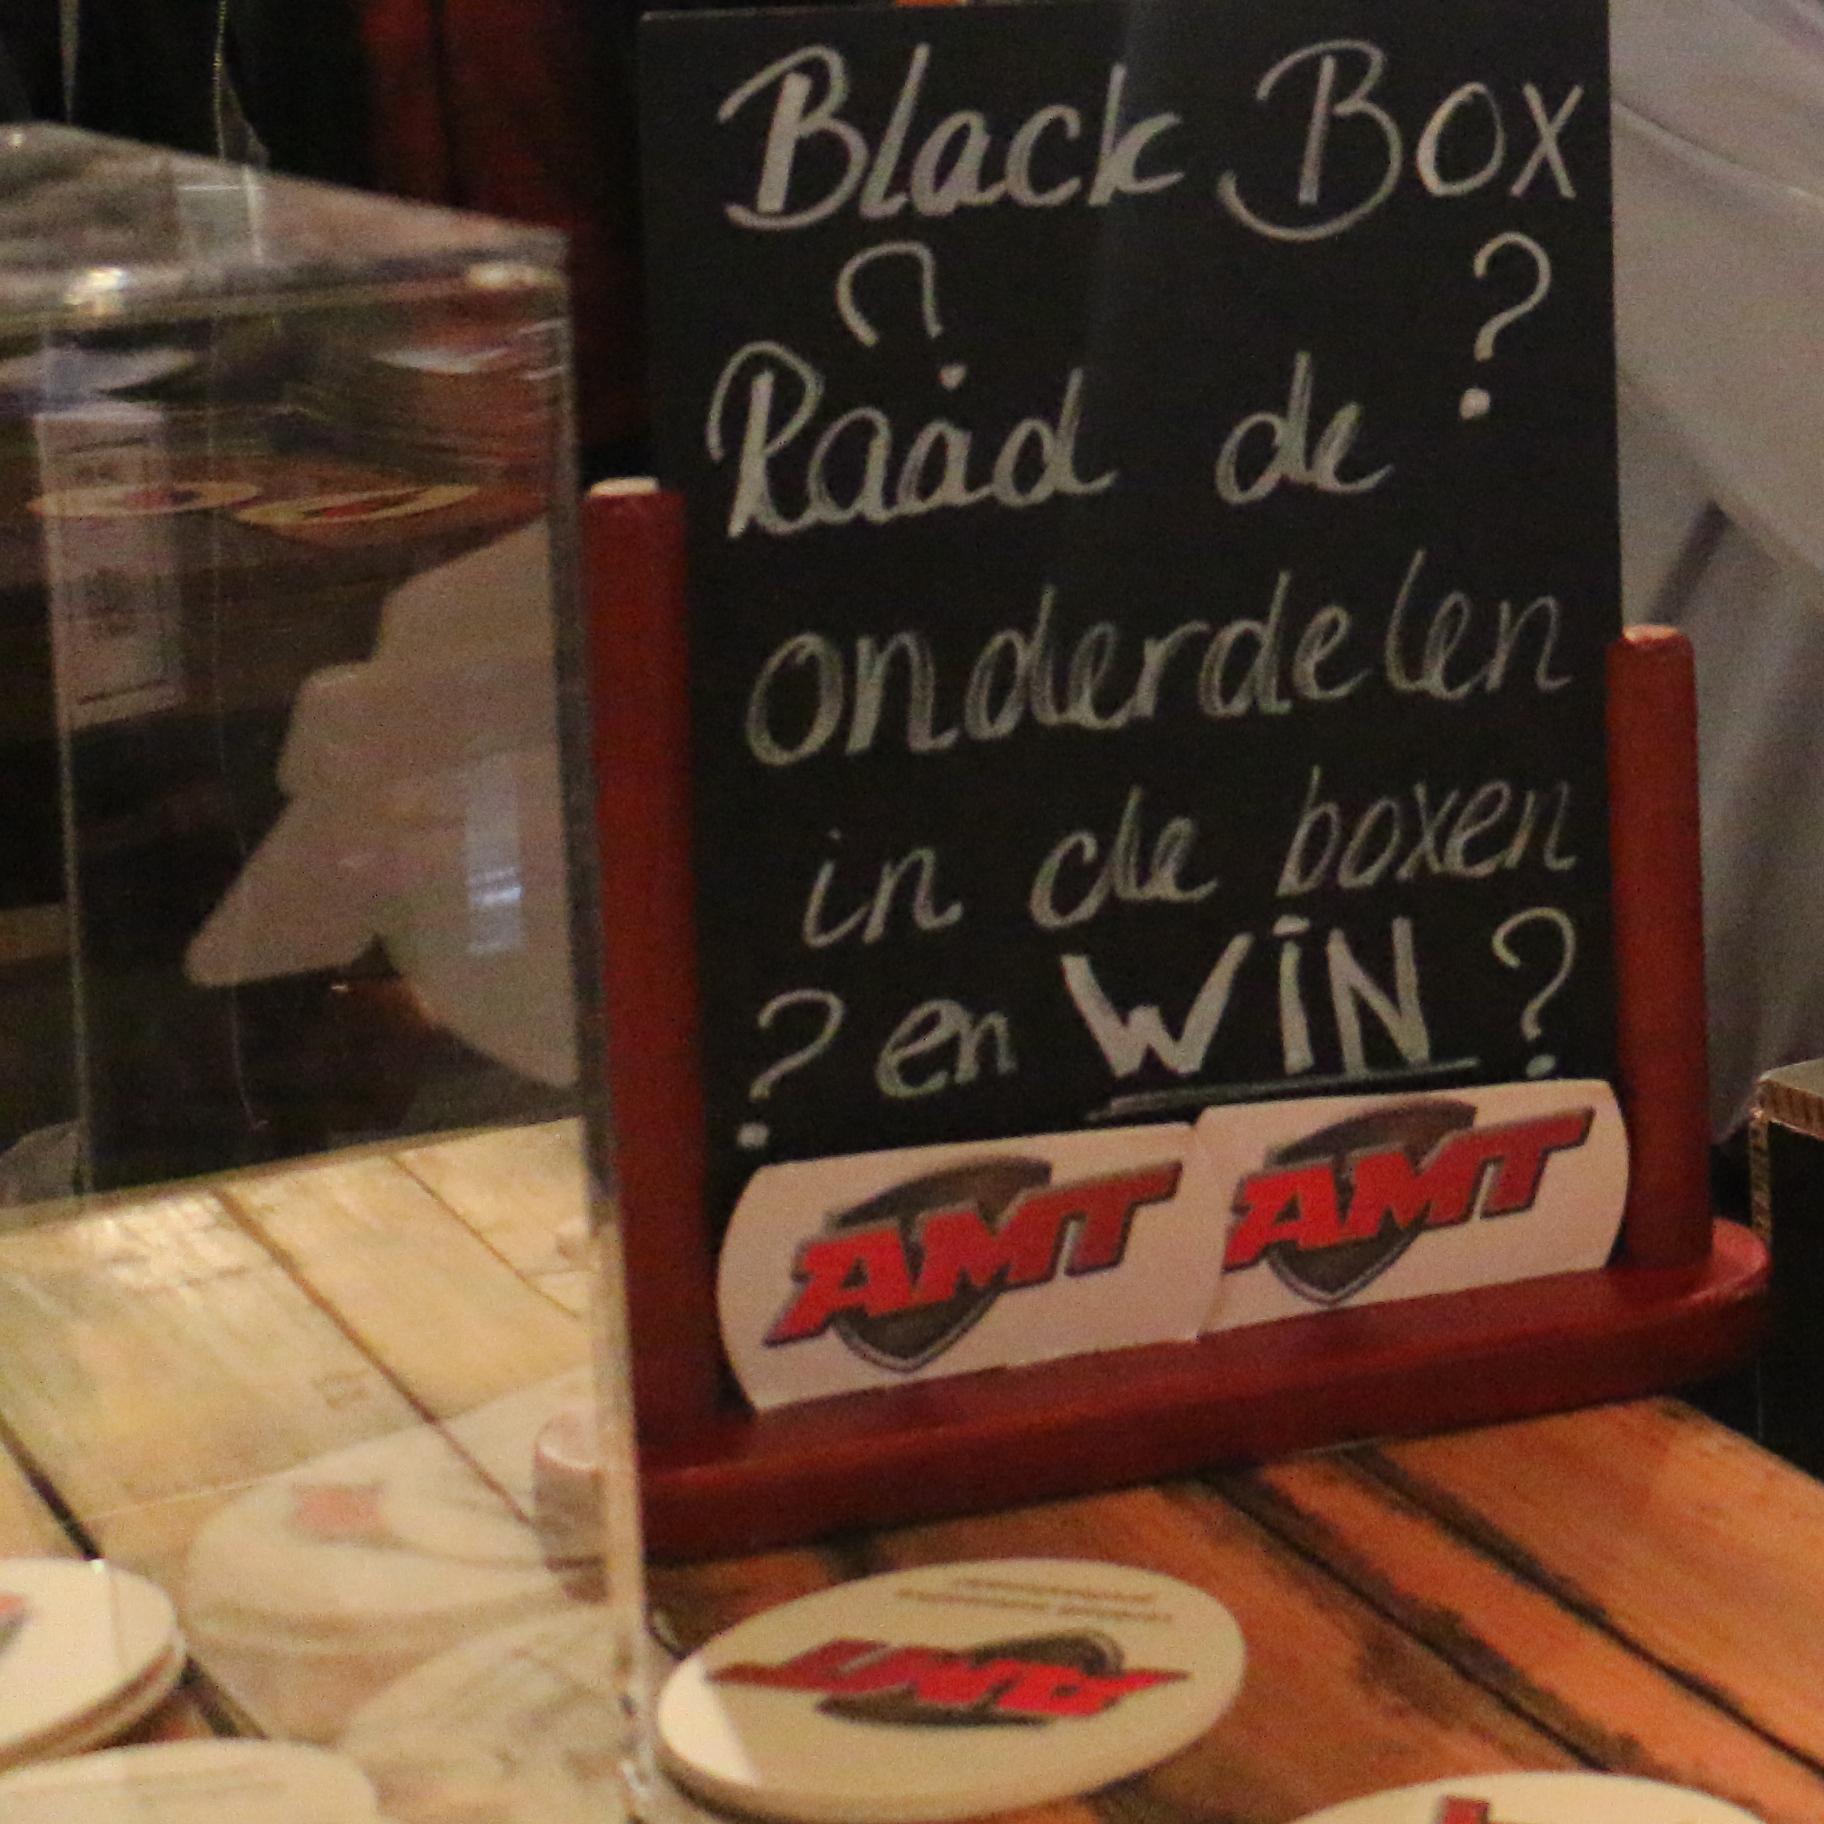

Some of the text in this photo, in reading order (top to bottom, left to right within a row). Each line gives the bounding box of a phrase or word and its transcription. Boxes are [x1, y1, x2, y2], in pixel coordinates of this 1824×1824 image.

[717, 42, 1186, 229] Black
[707, 341, 1394, 540] Raad de
[744, 548, 1572, 766] onderdelen
[800, 765, 1575, 950] in de boxen
[874, 996, 1019, 1100] en
[762, 1161, 1184, 1349] AMT
[1221, 1106, 1595, 1274] AMT
